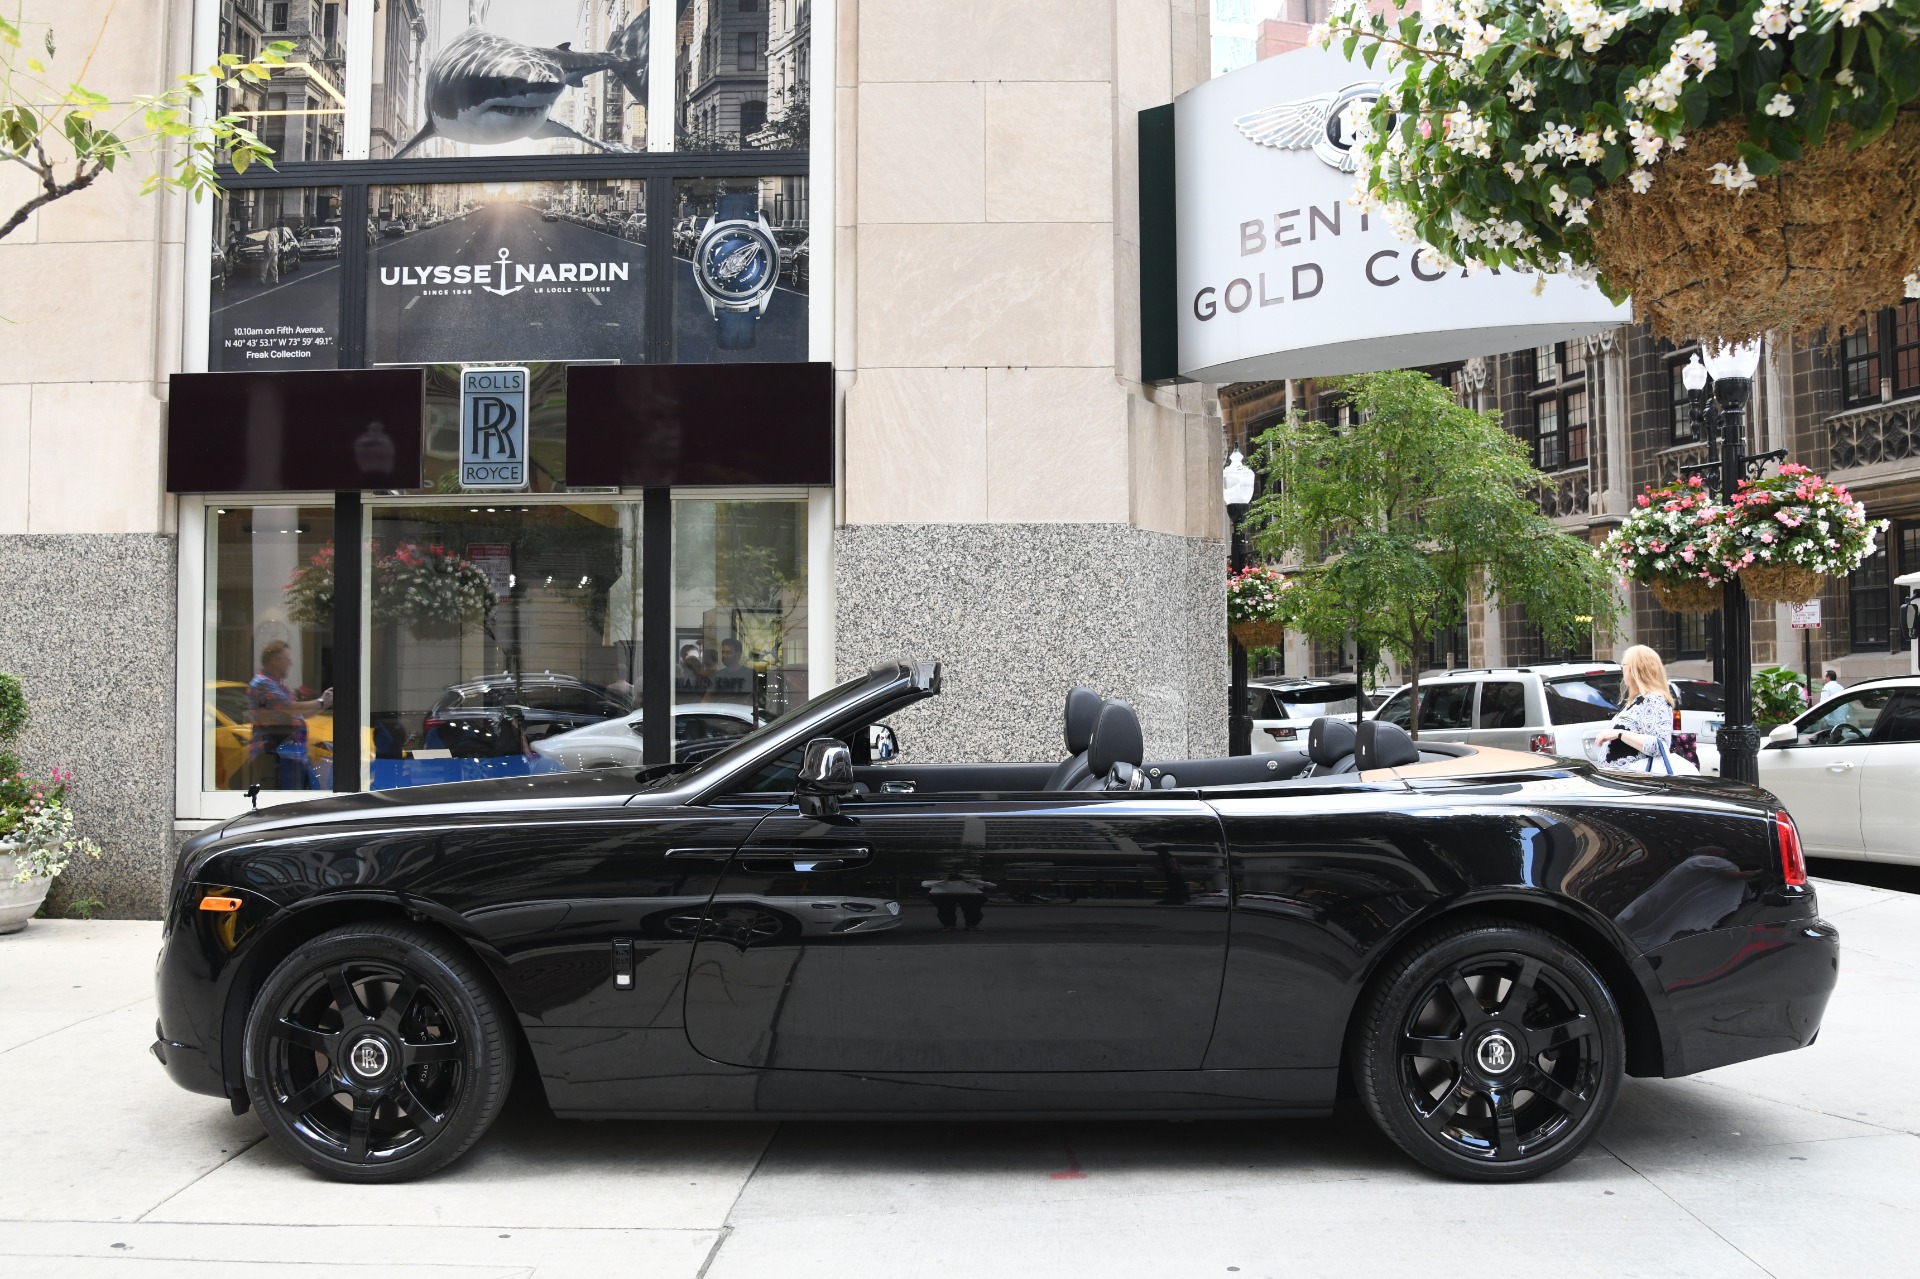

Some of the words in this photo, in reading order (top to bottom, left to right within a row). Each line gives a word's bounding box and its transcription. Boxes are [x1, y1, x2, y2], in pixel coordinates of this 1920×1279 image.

[380, 265, 492, 286] ULYSSE
[514, 262, 629, 283] NARDIN
[1193, 263, 1324, 322] GOLD
[233, 327, 264, 336] 10.10am
[276, 326, 294, 335] Fifth
[295, 325, 326, 334] Avenue.
[246, 351, 270, 359] Freak
[270, 349, 311, 359] Collection
[468, 375, 520, 389] ROLLS
[471, 396, 517, 460] RR
[466, 466, 519, 480] ROYCE
